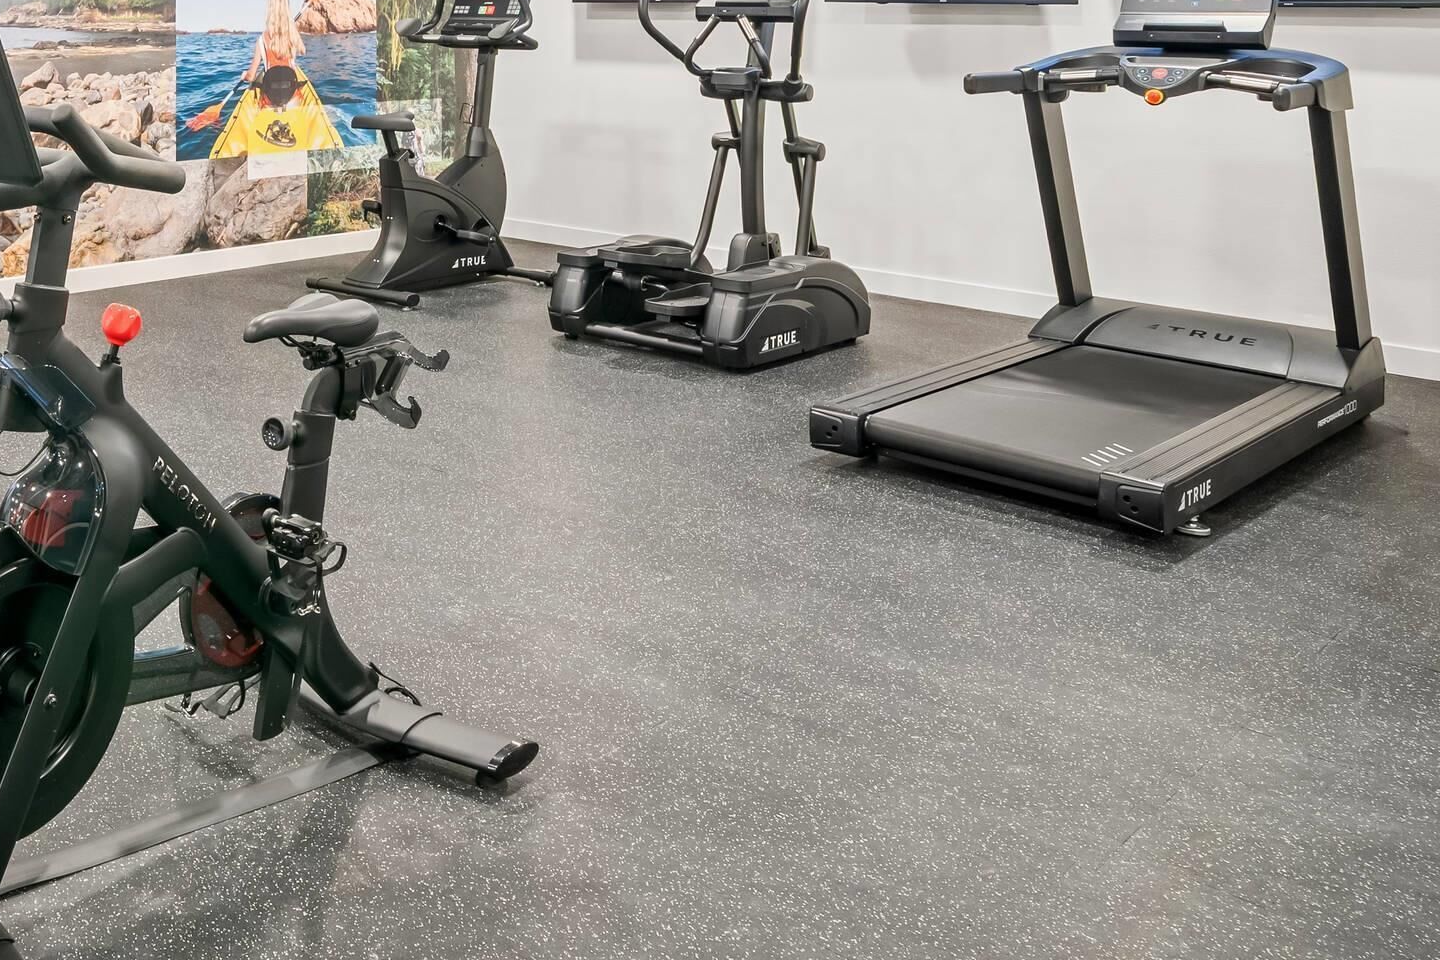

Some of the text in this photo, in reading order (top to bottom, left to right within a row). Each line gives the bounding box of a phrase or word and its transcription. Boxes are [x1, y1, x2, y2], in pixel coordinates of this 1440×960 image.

[460, 255, 486, 268] TRUE
[770, 330, 797, 349] TRUE
[1168, 325, 1257, 347] TRUE
[152, 456, 217, 533] PELOTON
[1186, 478, 1212, 507] TRUE
